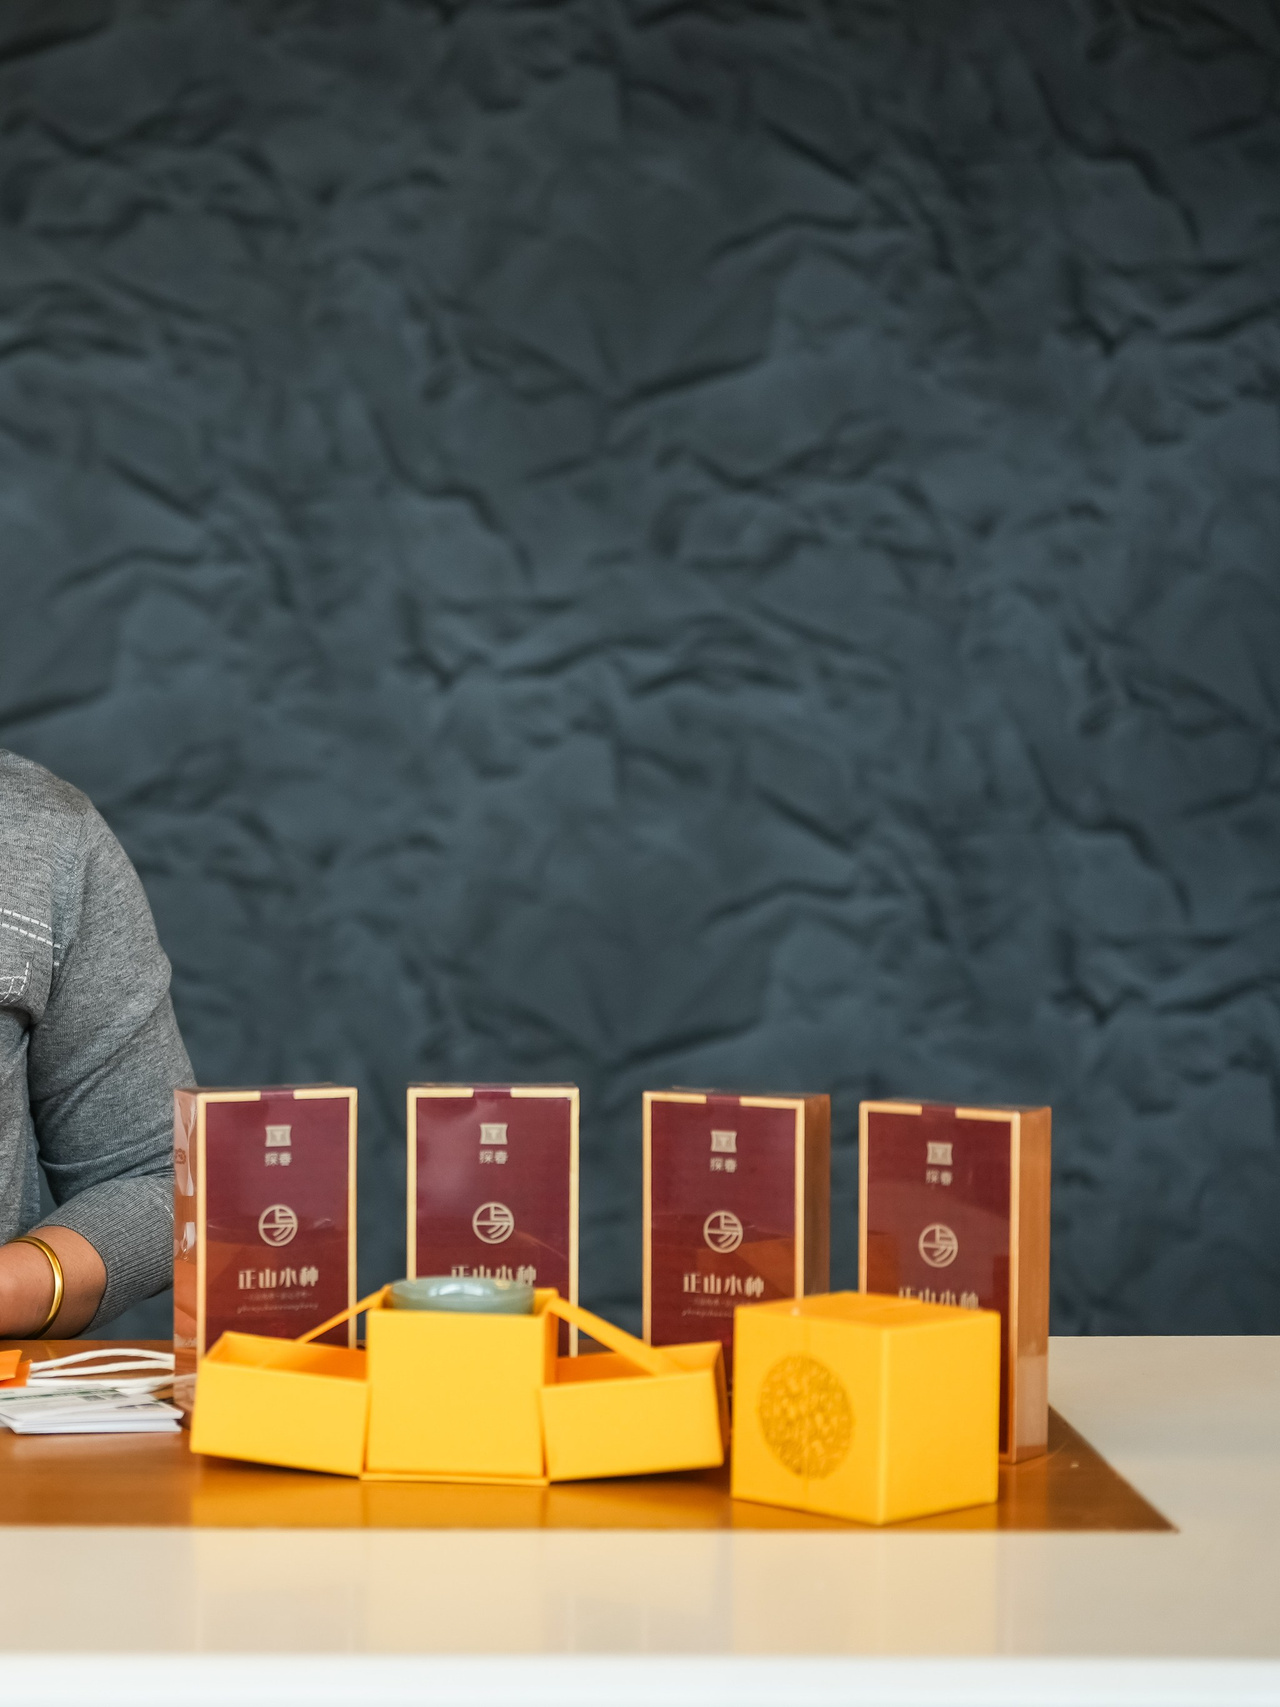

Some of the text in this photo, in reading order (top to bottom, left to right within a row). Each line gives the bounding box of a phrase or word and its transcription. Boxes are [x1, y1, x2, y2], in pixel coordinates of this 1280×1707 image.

[238, 1266, 319, 1290] 正山小种
[683, 1272, 765, 1298] 正山小种
